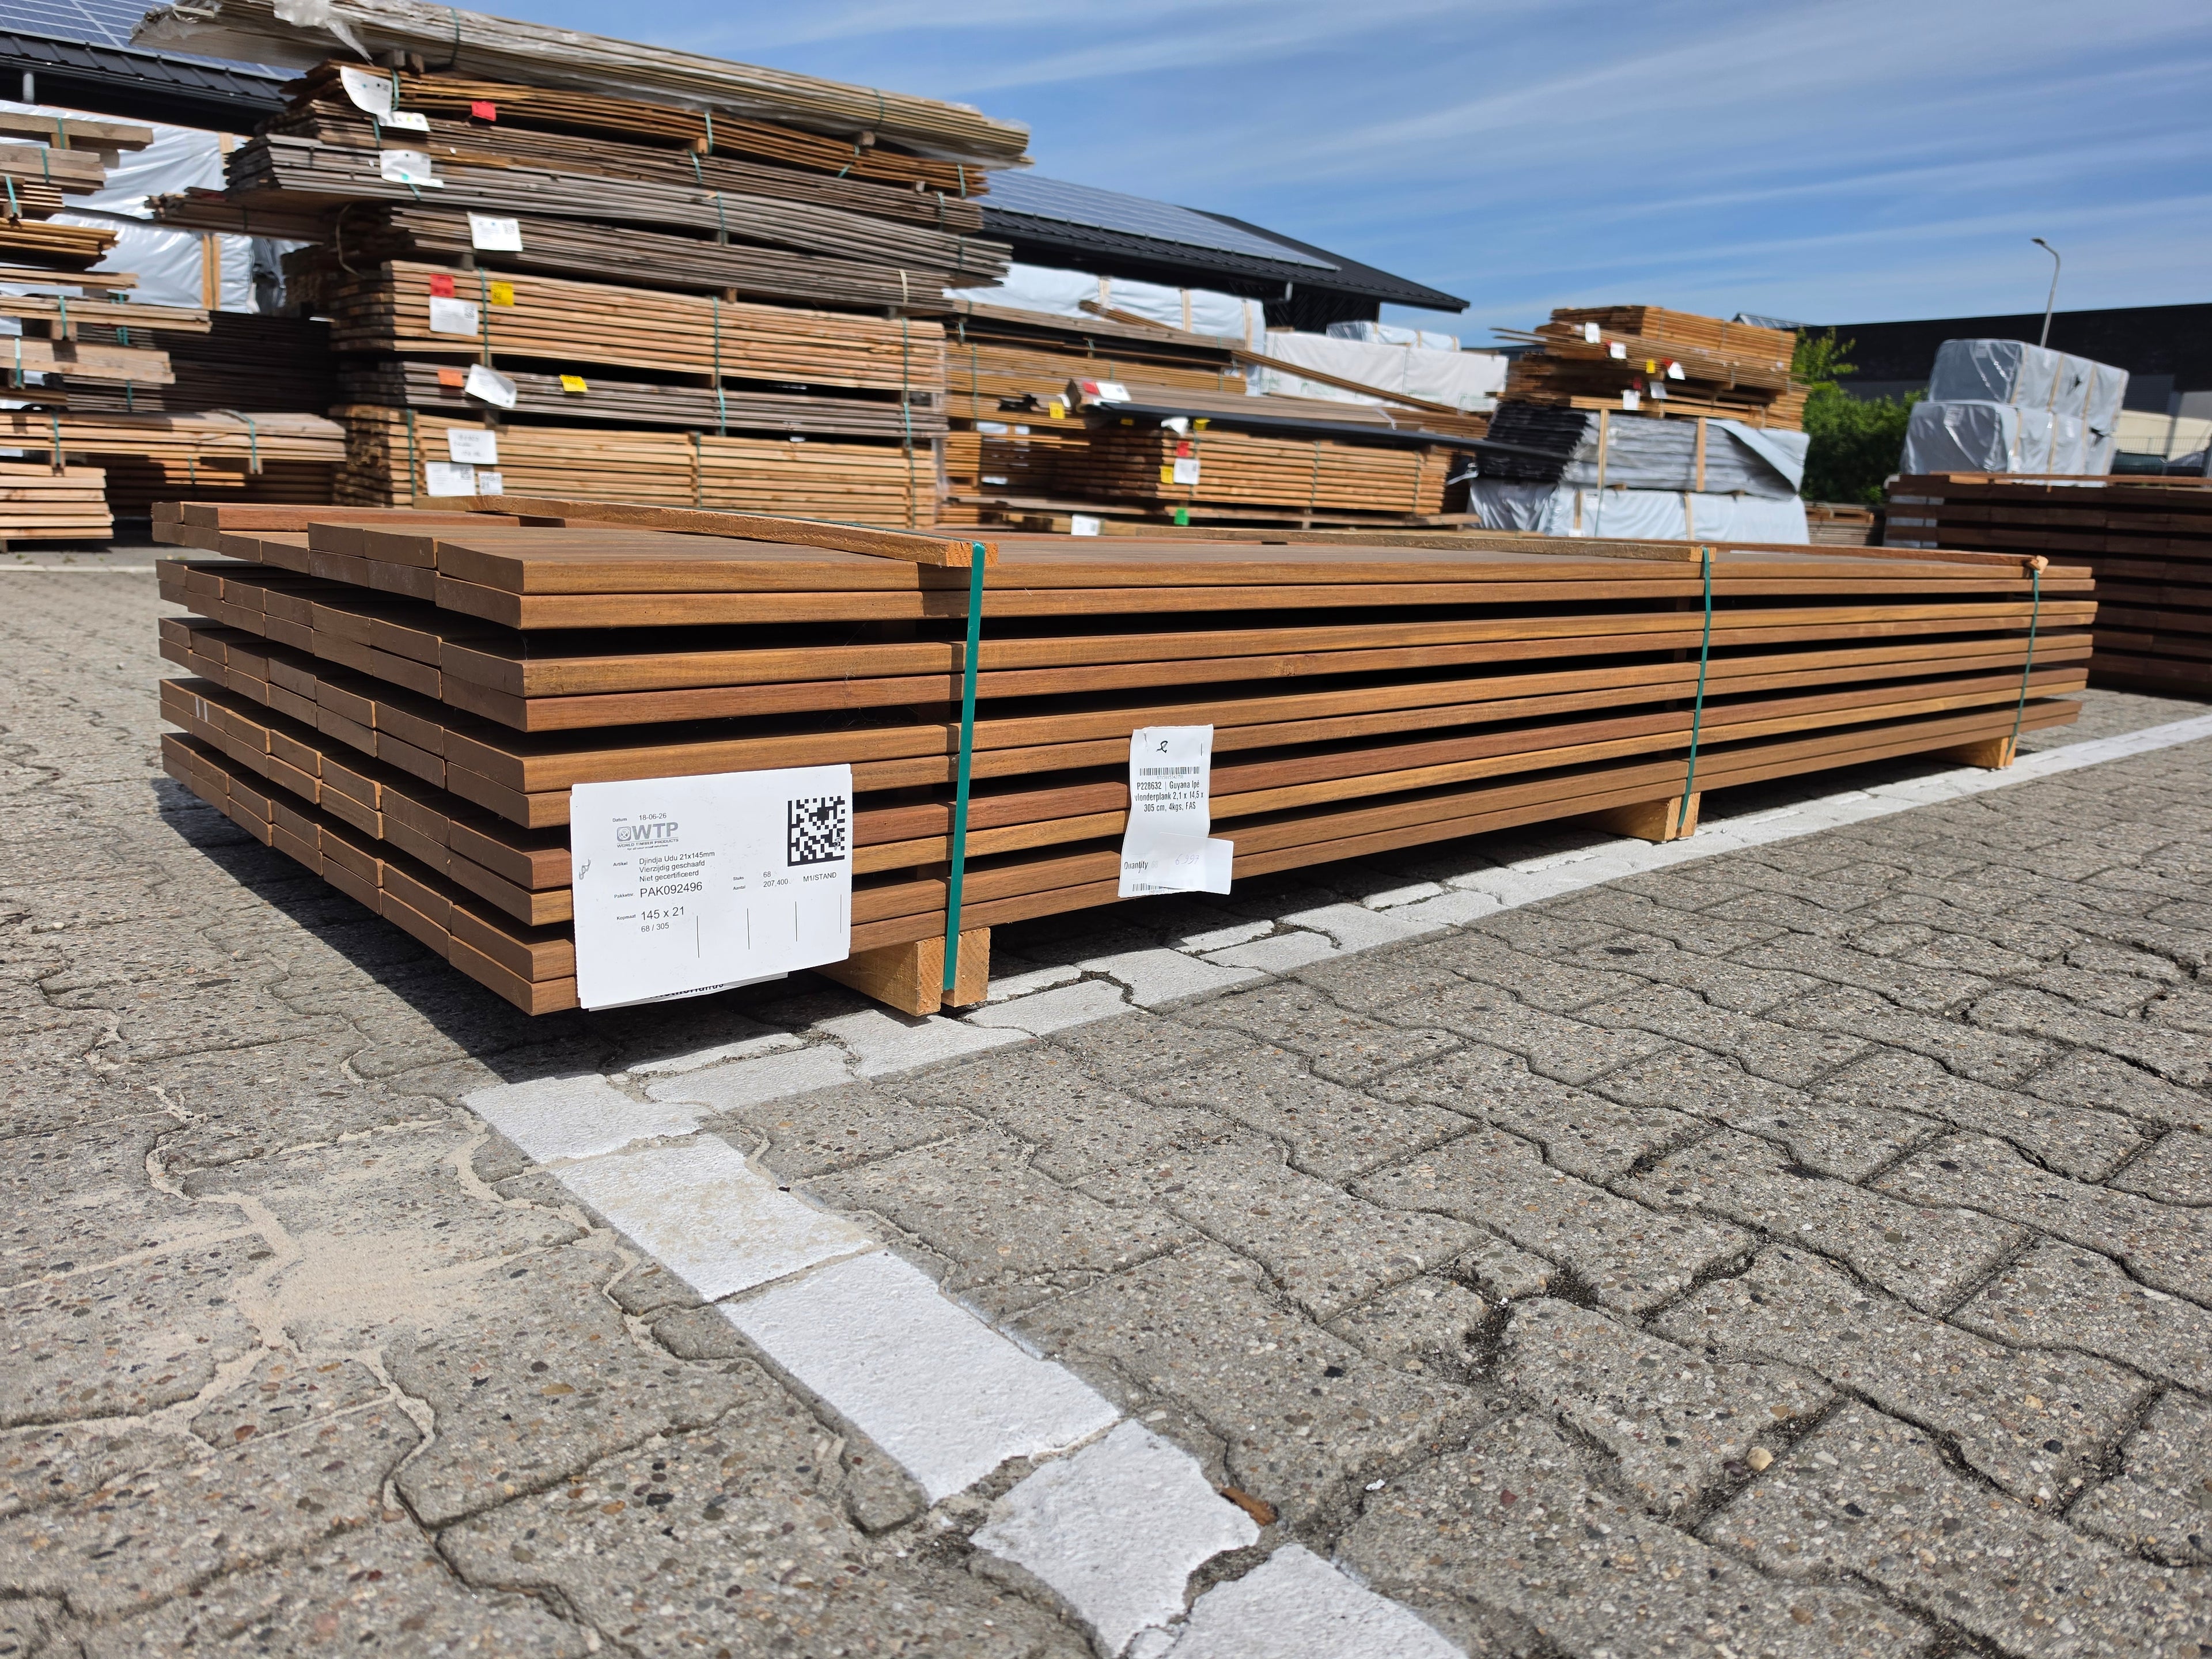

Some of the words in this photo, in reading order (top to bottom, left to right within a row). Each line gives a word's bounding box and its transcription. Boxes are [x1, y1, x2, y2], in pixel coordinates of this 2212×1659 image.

[1137, 782, 1162, 790] P228632
[1169, 781, 1190, 790] Guyana
[1192, 780, 1200, 789] Ipé
[1134, 792, 1171, 802] vlonderplank
[1173, 791, 1181, 801] 2,1
[1190, 790, 1199, 799] 14,5
[1144, 804, 1154, 812] 305
[1185, 801, 1196, 809] FAS
[631, 822, 679, 840] WTP
[639, 857, 662, 865] Djindja
[679, 851, 715, 860] 21x145mm
[639, 864, 670, 873] Vierzijdig
[671, 860, 705, 871] geschaafd
[654, 870, 699, 882] gecertificeerd
[803, 872, 837, 882] M1/STAND
[640, 881, 703, 898] PAK092496
[641, 910, 660, 921] 145
[672, 906, 684, 916] 21
[656, 922, 669, 930] 305
